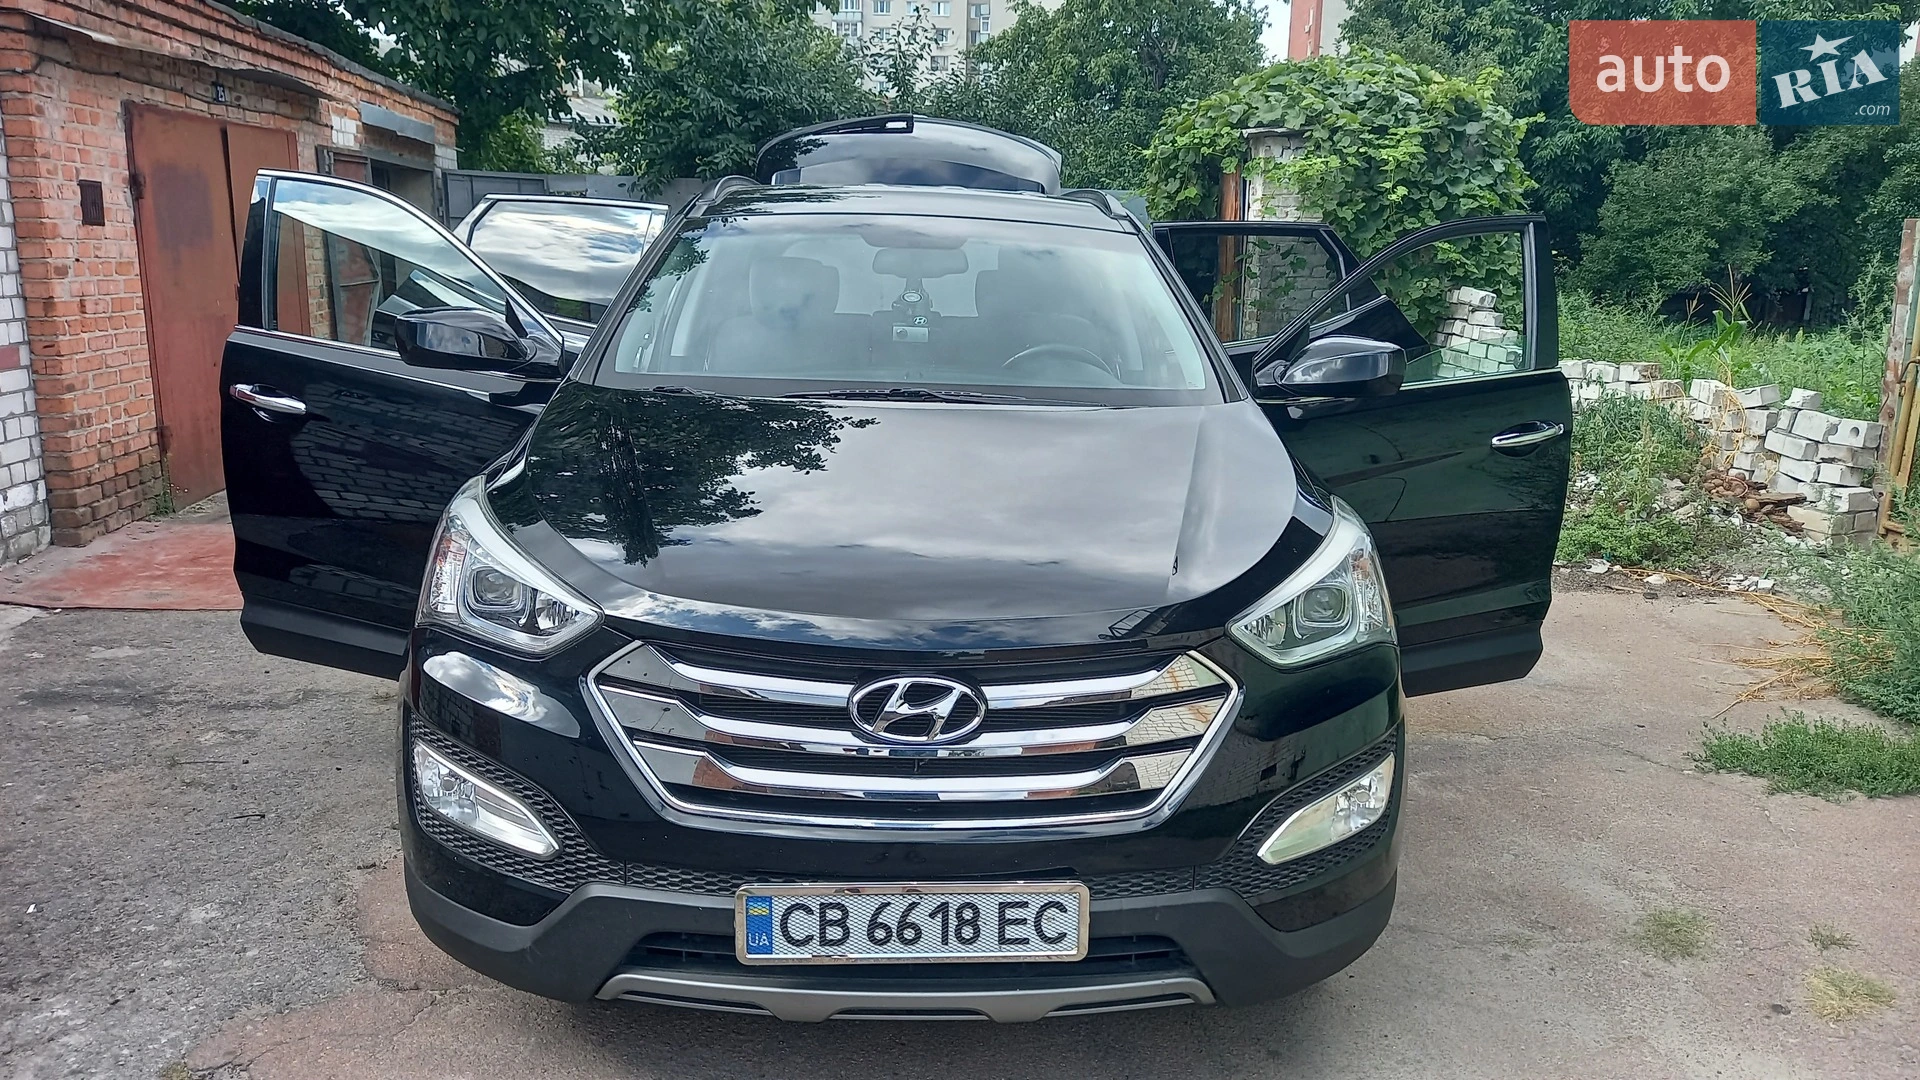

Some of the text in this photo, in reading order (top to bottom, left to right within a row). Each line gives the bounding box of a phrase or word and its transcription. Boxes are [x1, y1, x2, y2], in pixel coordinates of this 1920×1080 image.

[779, 900, 1068, 947] CB 6618 EC
[748, 932, 770, 947] UA
